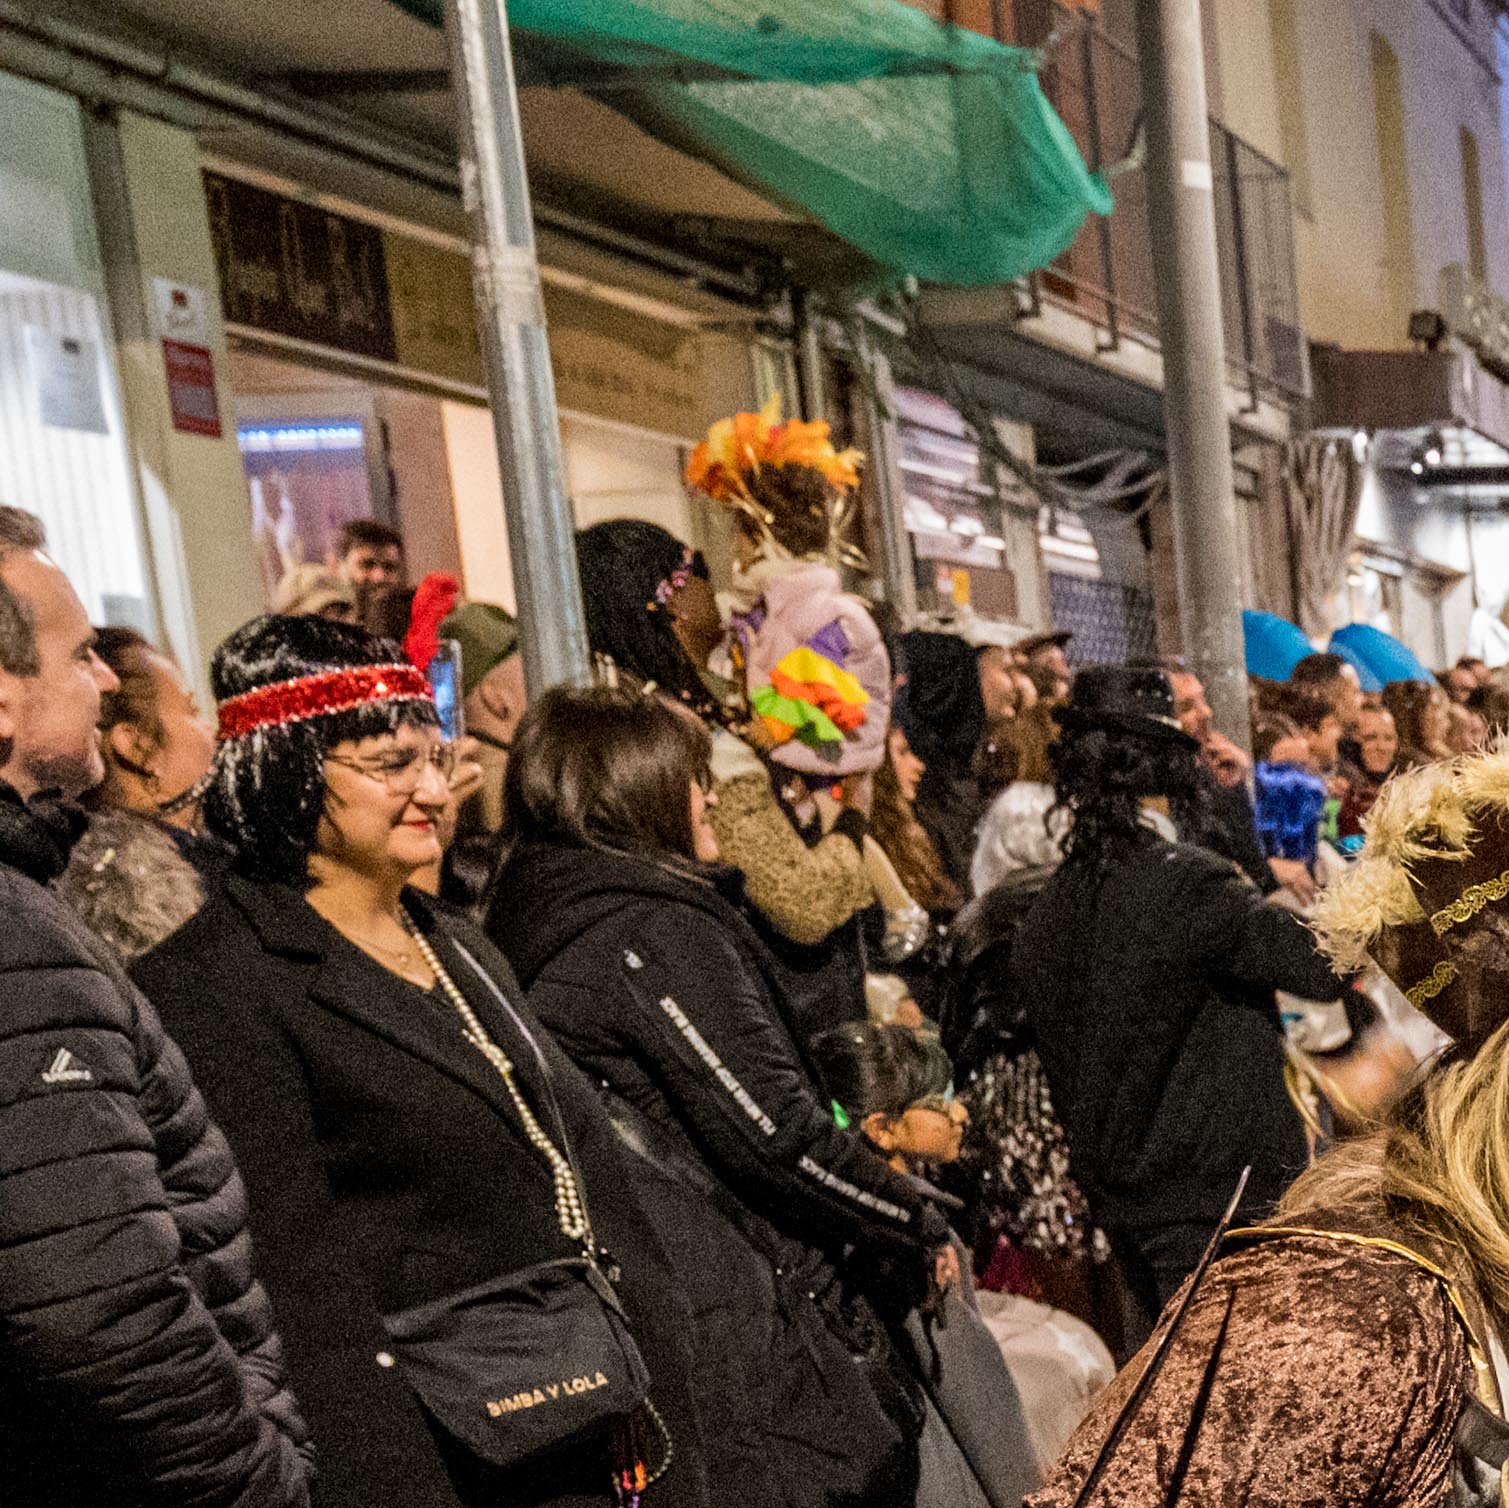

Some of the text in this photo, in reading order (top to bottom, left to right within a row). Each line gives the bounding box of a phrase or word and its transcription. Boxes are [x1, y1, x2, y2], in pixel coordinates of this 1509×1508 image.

[486, 1370, 609, 1418] BIMBA Y LOLA
